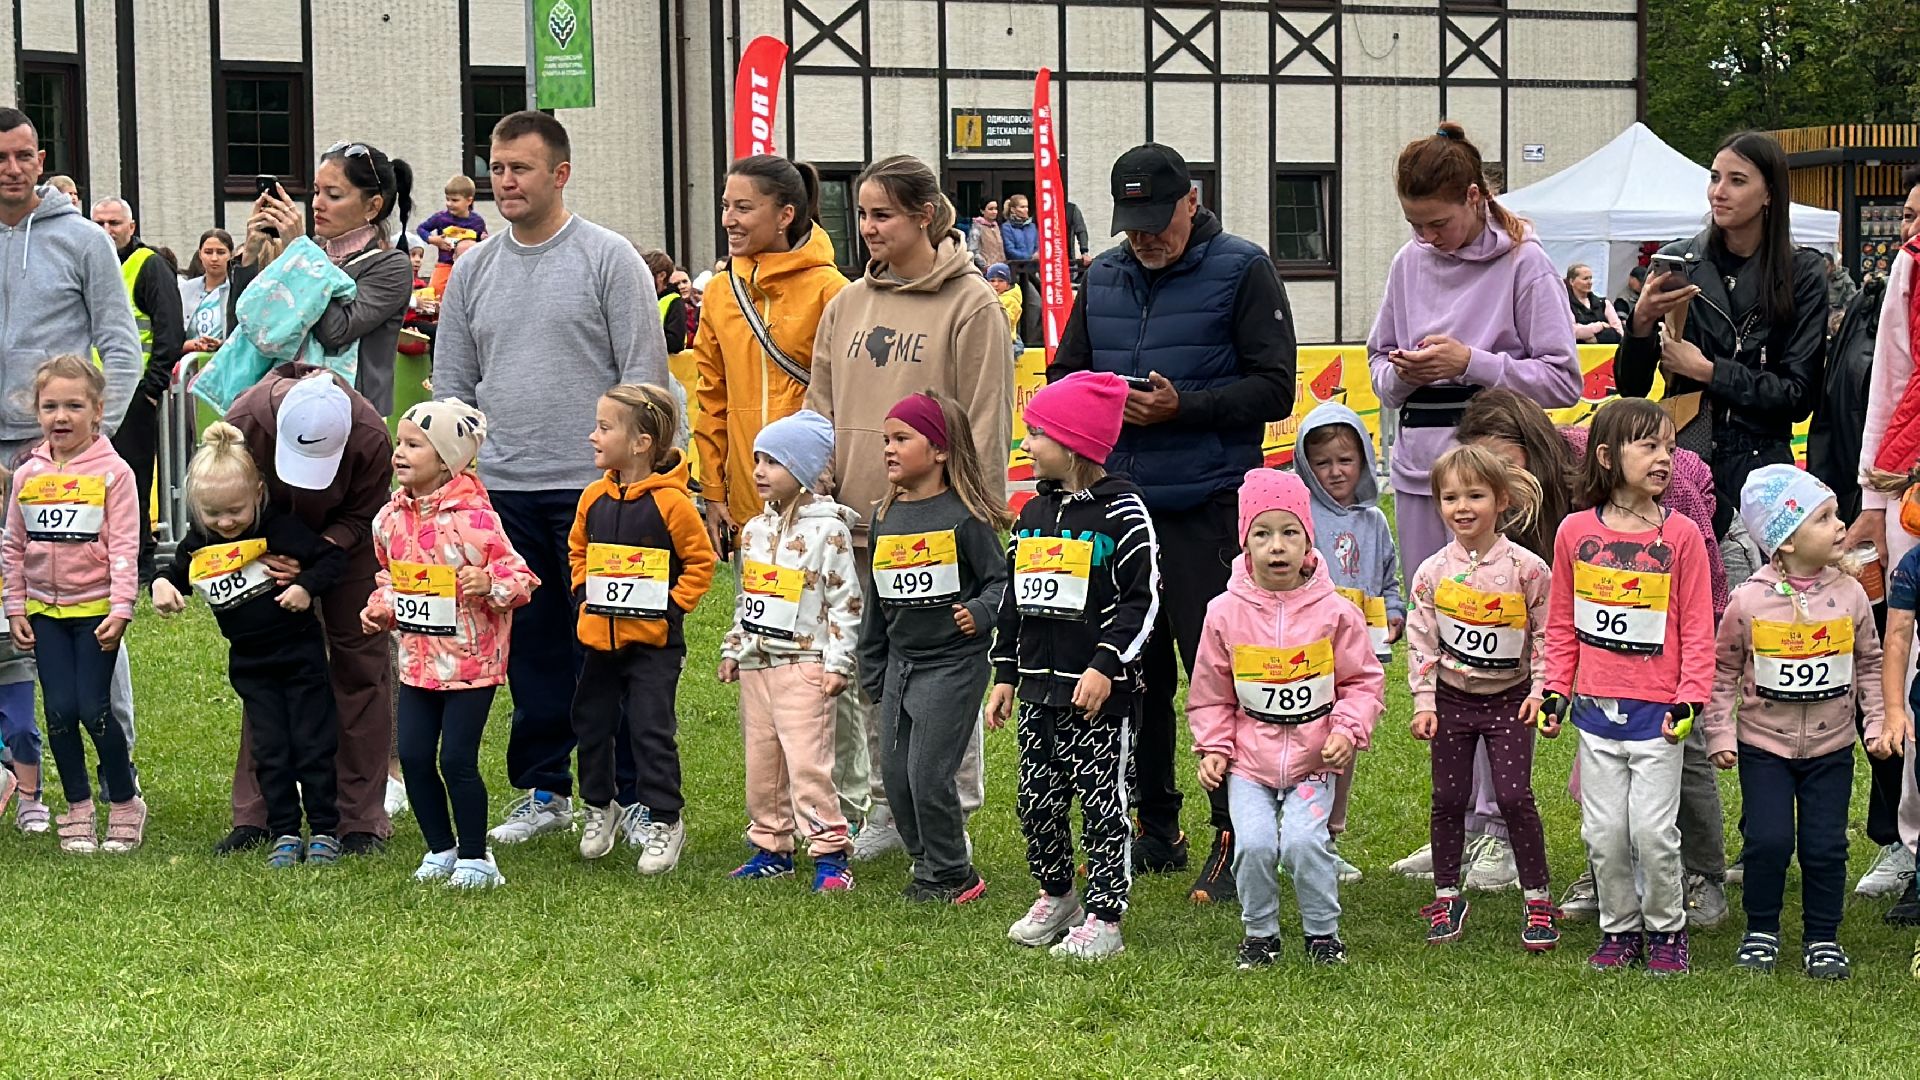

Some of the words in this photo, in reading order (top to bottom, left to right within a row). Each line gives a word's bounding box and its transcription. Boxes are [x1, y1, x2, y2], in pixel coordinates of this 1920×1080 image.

[987, 115, 1034, 124] ОДИНЦОВСКА
[987, 127, 1017, 135] ДЕТСКАЯ
[987, 138, 1011, 147] ШКОЛА
[37, 509, 79, 528] 497
[210, 570, 247, 600] 498
[606, 582, 634, 603] 87
[892, 571, 933, 595] 499
[1021, 578, 1059, 601] 599
[397, 597, 431, 621] 594
[1595, 609, 1628, 635] 96
[1453, 624, 1498, 655] 790
[1778, 662, 1830, 687] 592
[1261, 686, 1312, 711] 789
